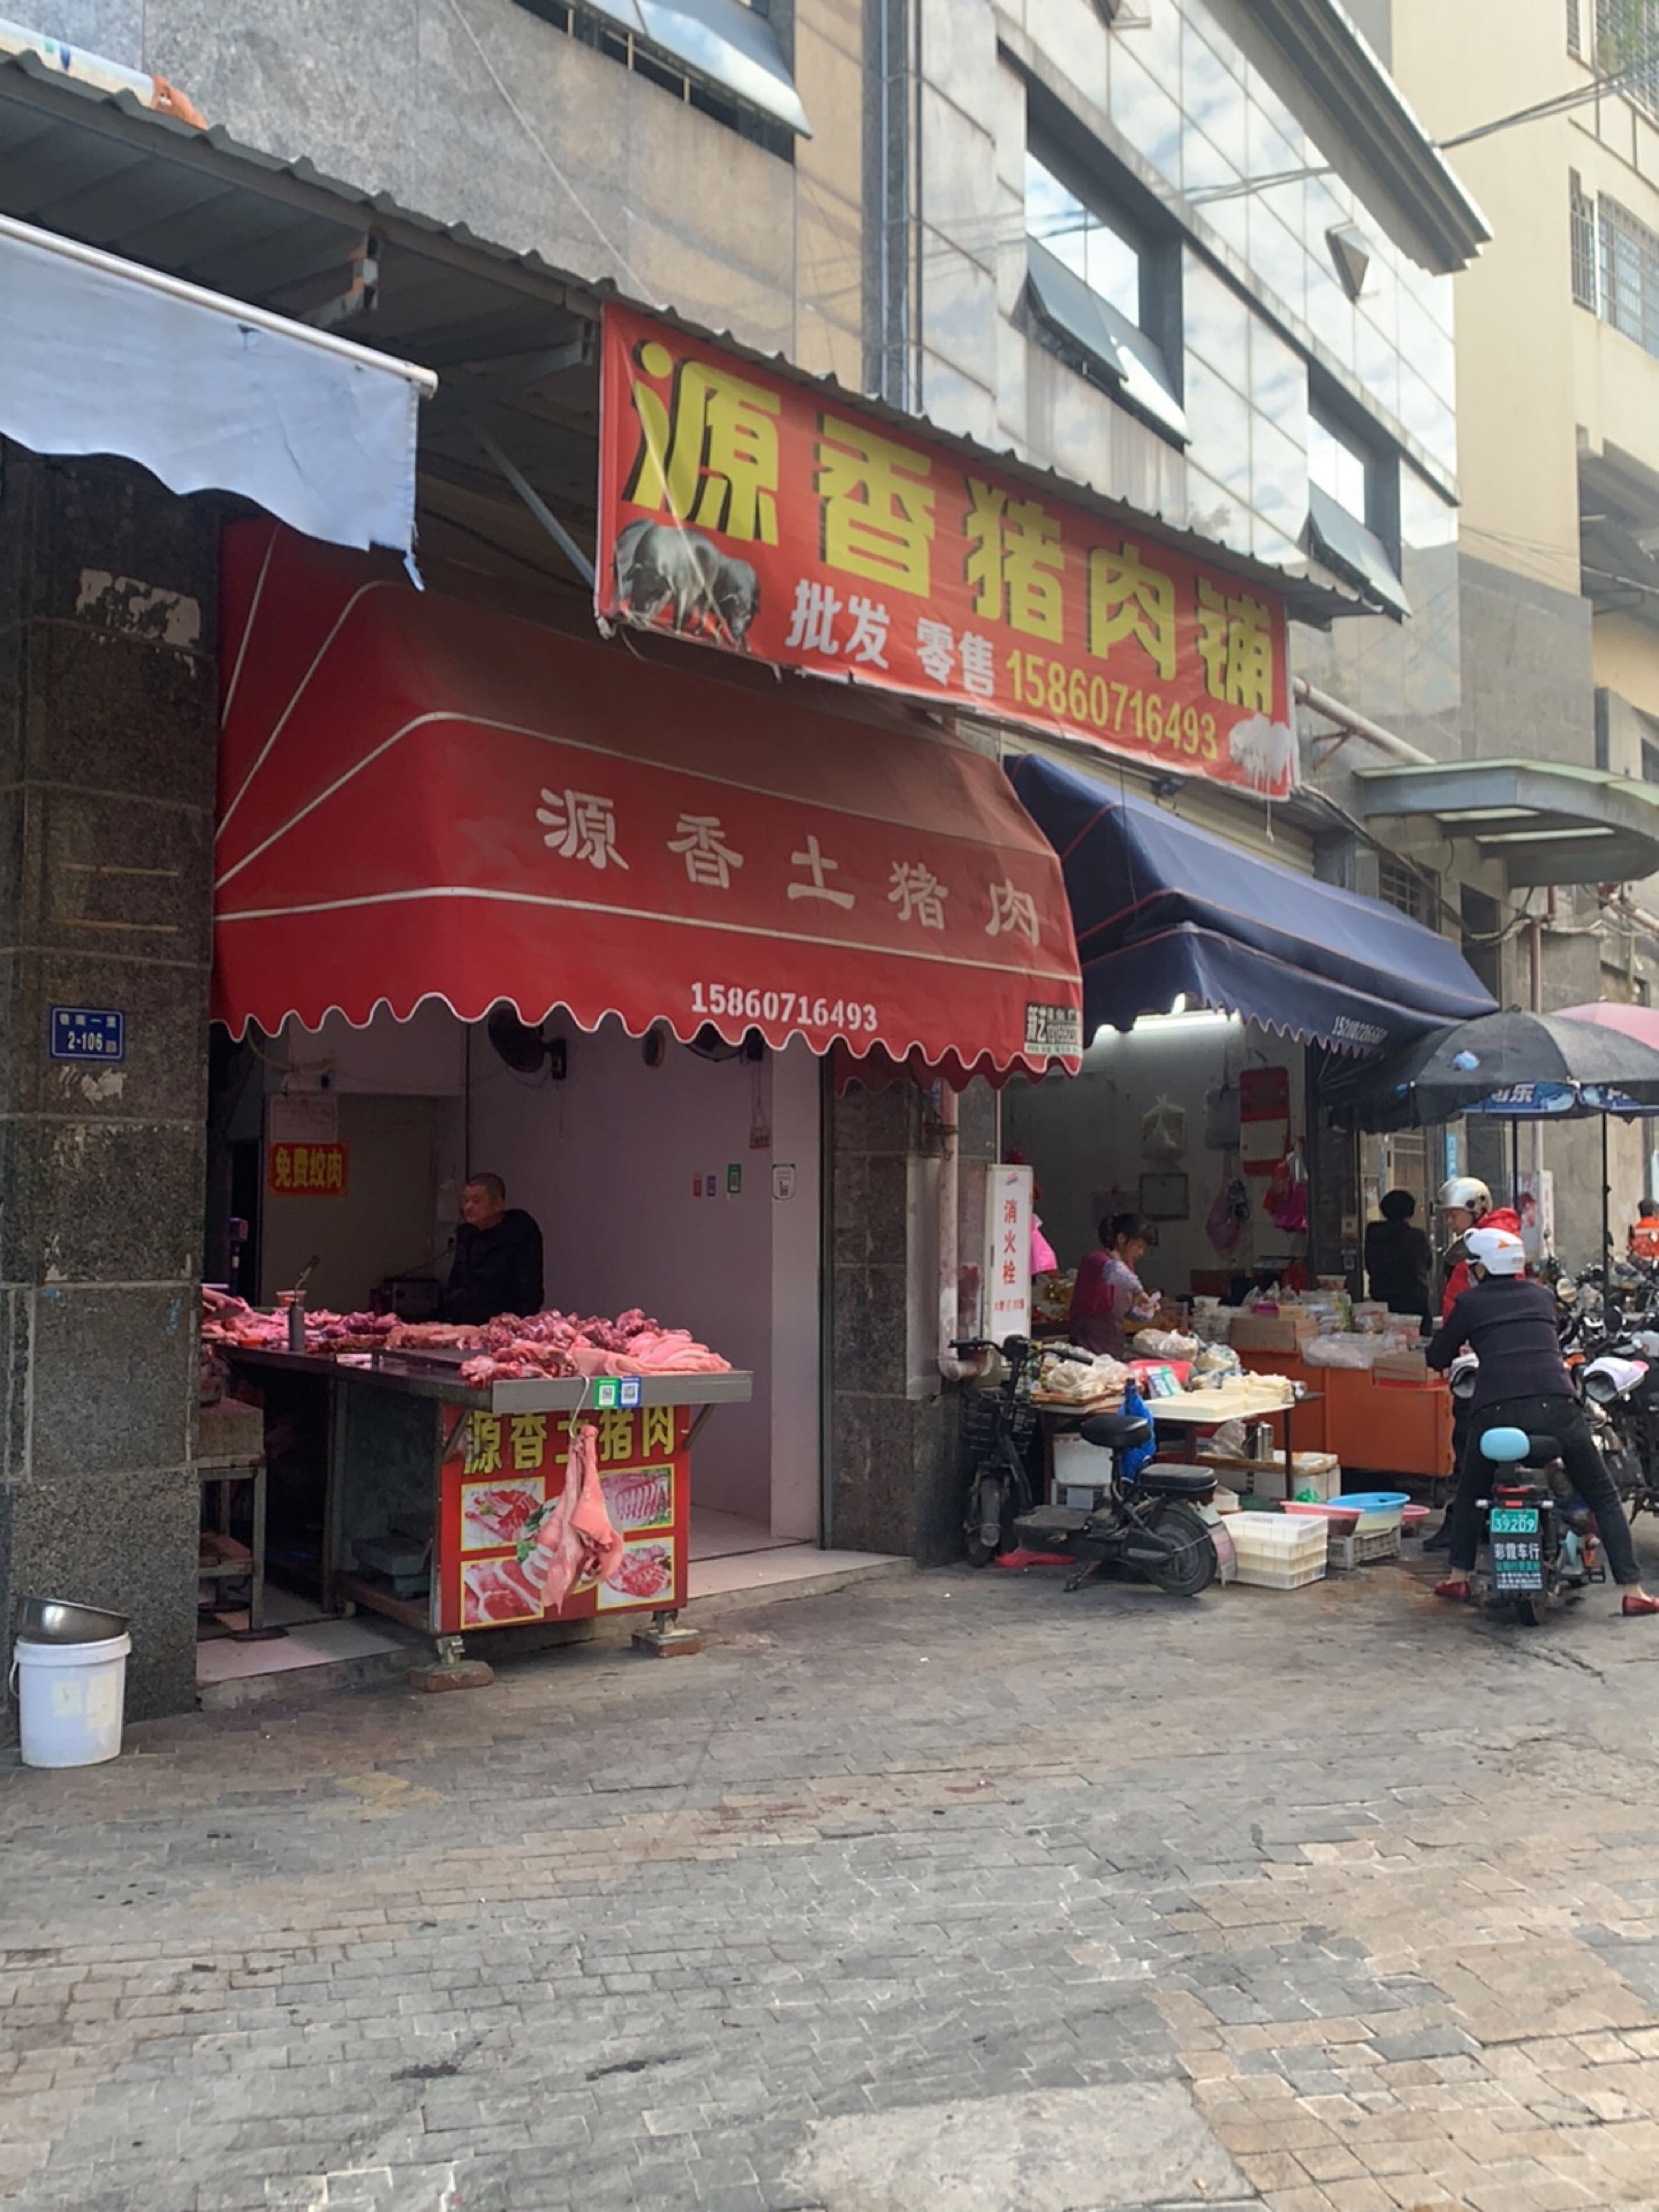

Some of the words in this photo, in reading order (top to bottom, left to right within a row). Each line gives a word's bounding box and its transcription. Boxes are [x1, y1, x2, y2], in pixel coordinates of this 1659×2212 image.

[630, 341, 1272, 715] 源香猪肉铺
[785, 578, 890, 669] 批发
[917, 616, 995, 698] 零售
[1006, 649, 1217, 761] 15860716493
[535, 787, 1040, 945] 源香土猪肉
[690, 981, 878, 1033] 15860716493
[1003, 1198, 1018, 1285] 消火栓
